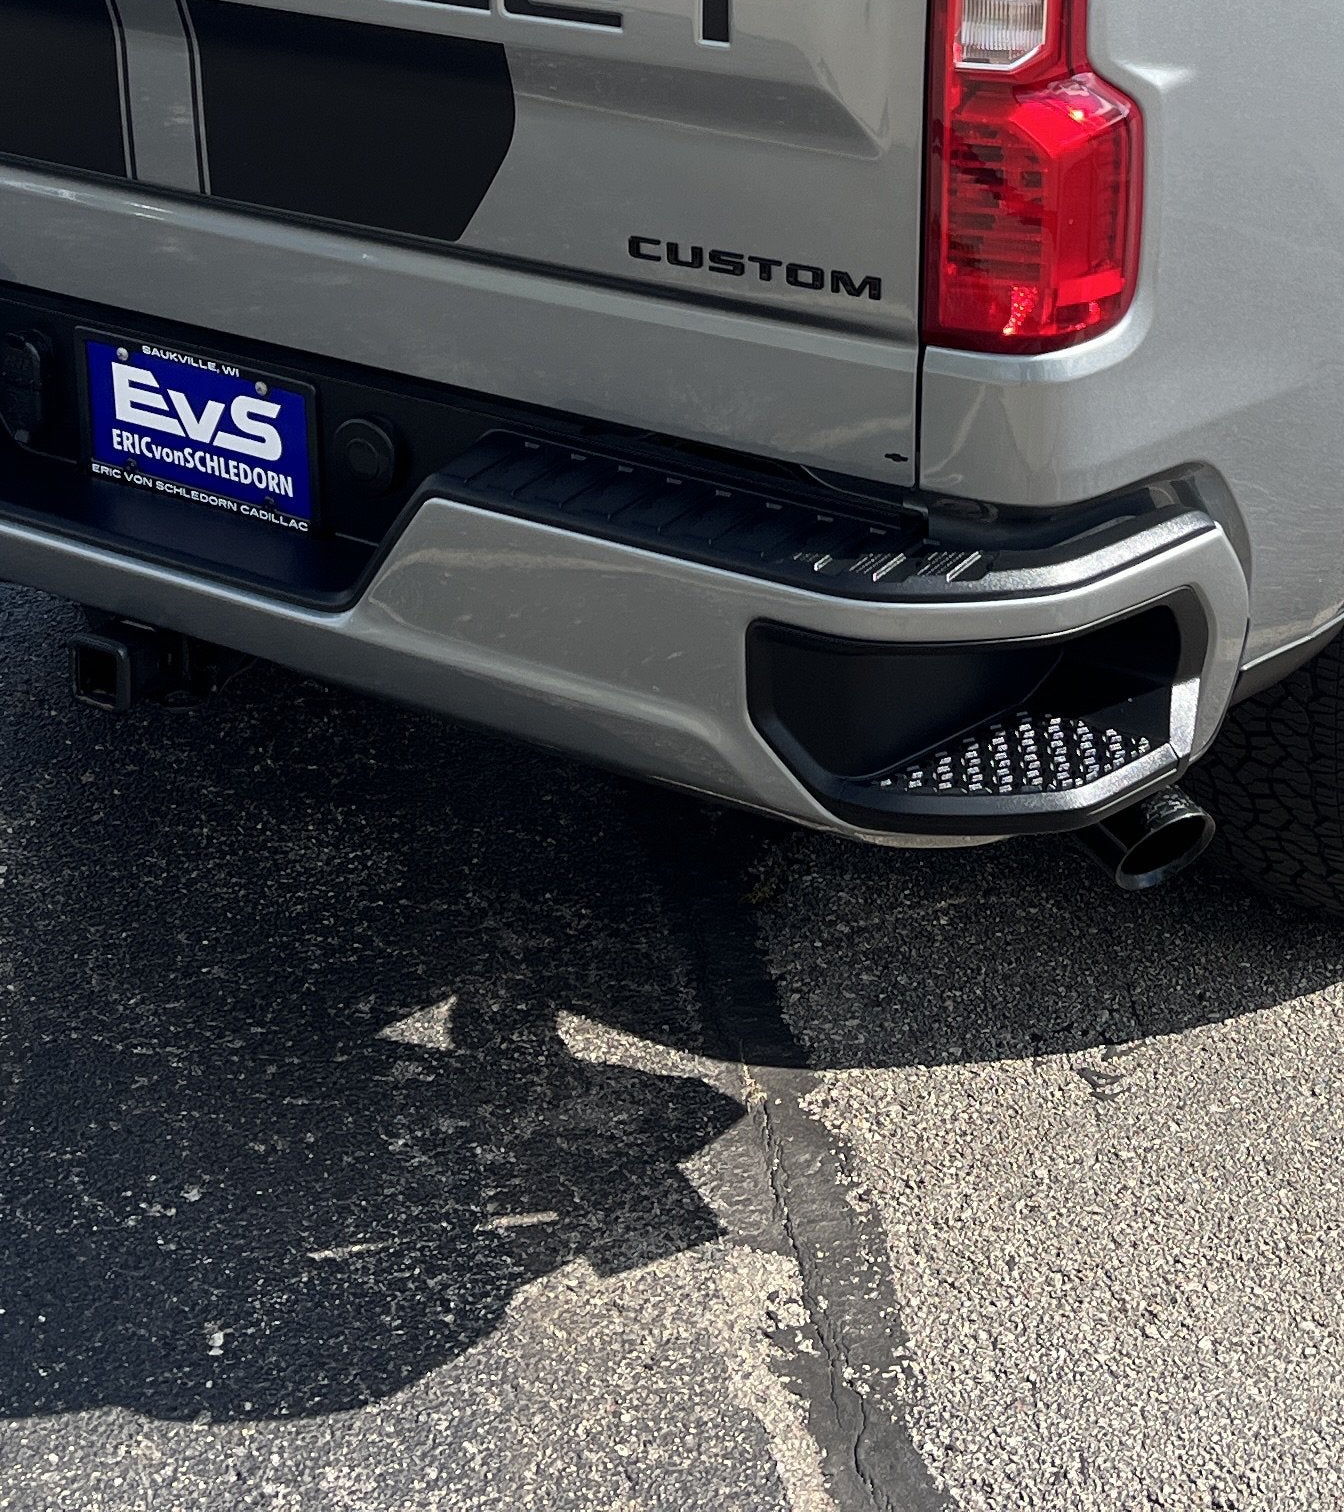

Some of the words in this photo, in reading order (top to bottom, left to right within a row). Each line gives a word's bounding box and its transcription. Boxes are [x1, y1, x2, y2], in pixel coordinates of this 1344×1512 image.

[628, 235, 882, 301] CUSTOM
[142, 345, 220, 374] SAUKVILLE,
[222, 364, 240, 378] WI
[112, 429, 294, 498] ERICvonSCHLEDORN
[91, 463, 122, 479] ERIC
[123, 471, 154, 488] VON
[155, 480, 238, 511] SCHLEDORN
[240, 505, 309, 532] CADILLAC
